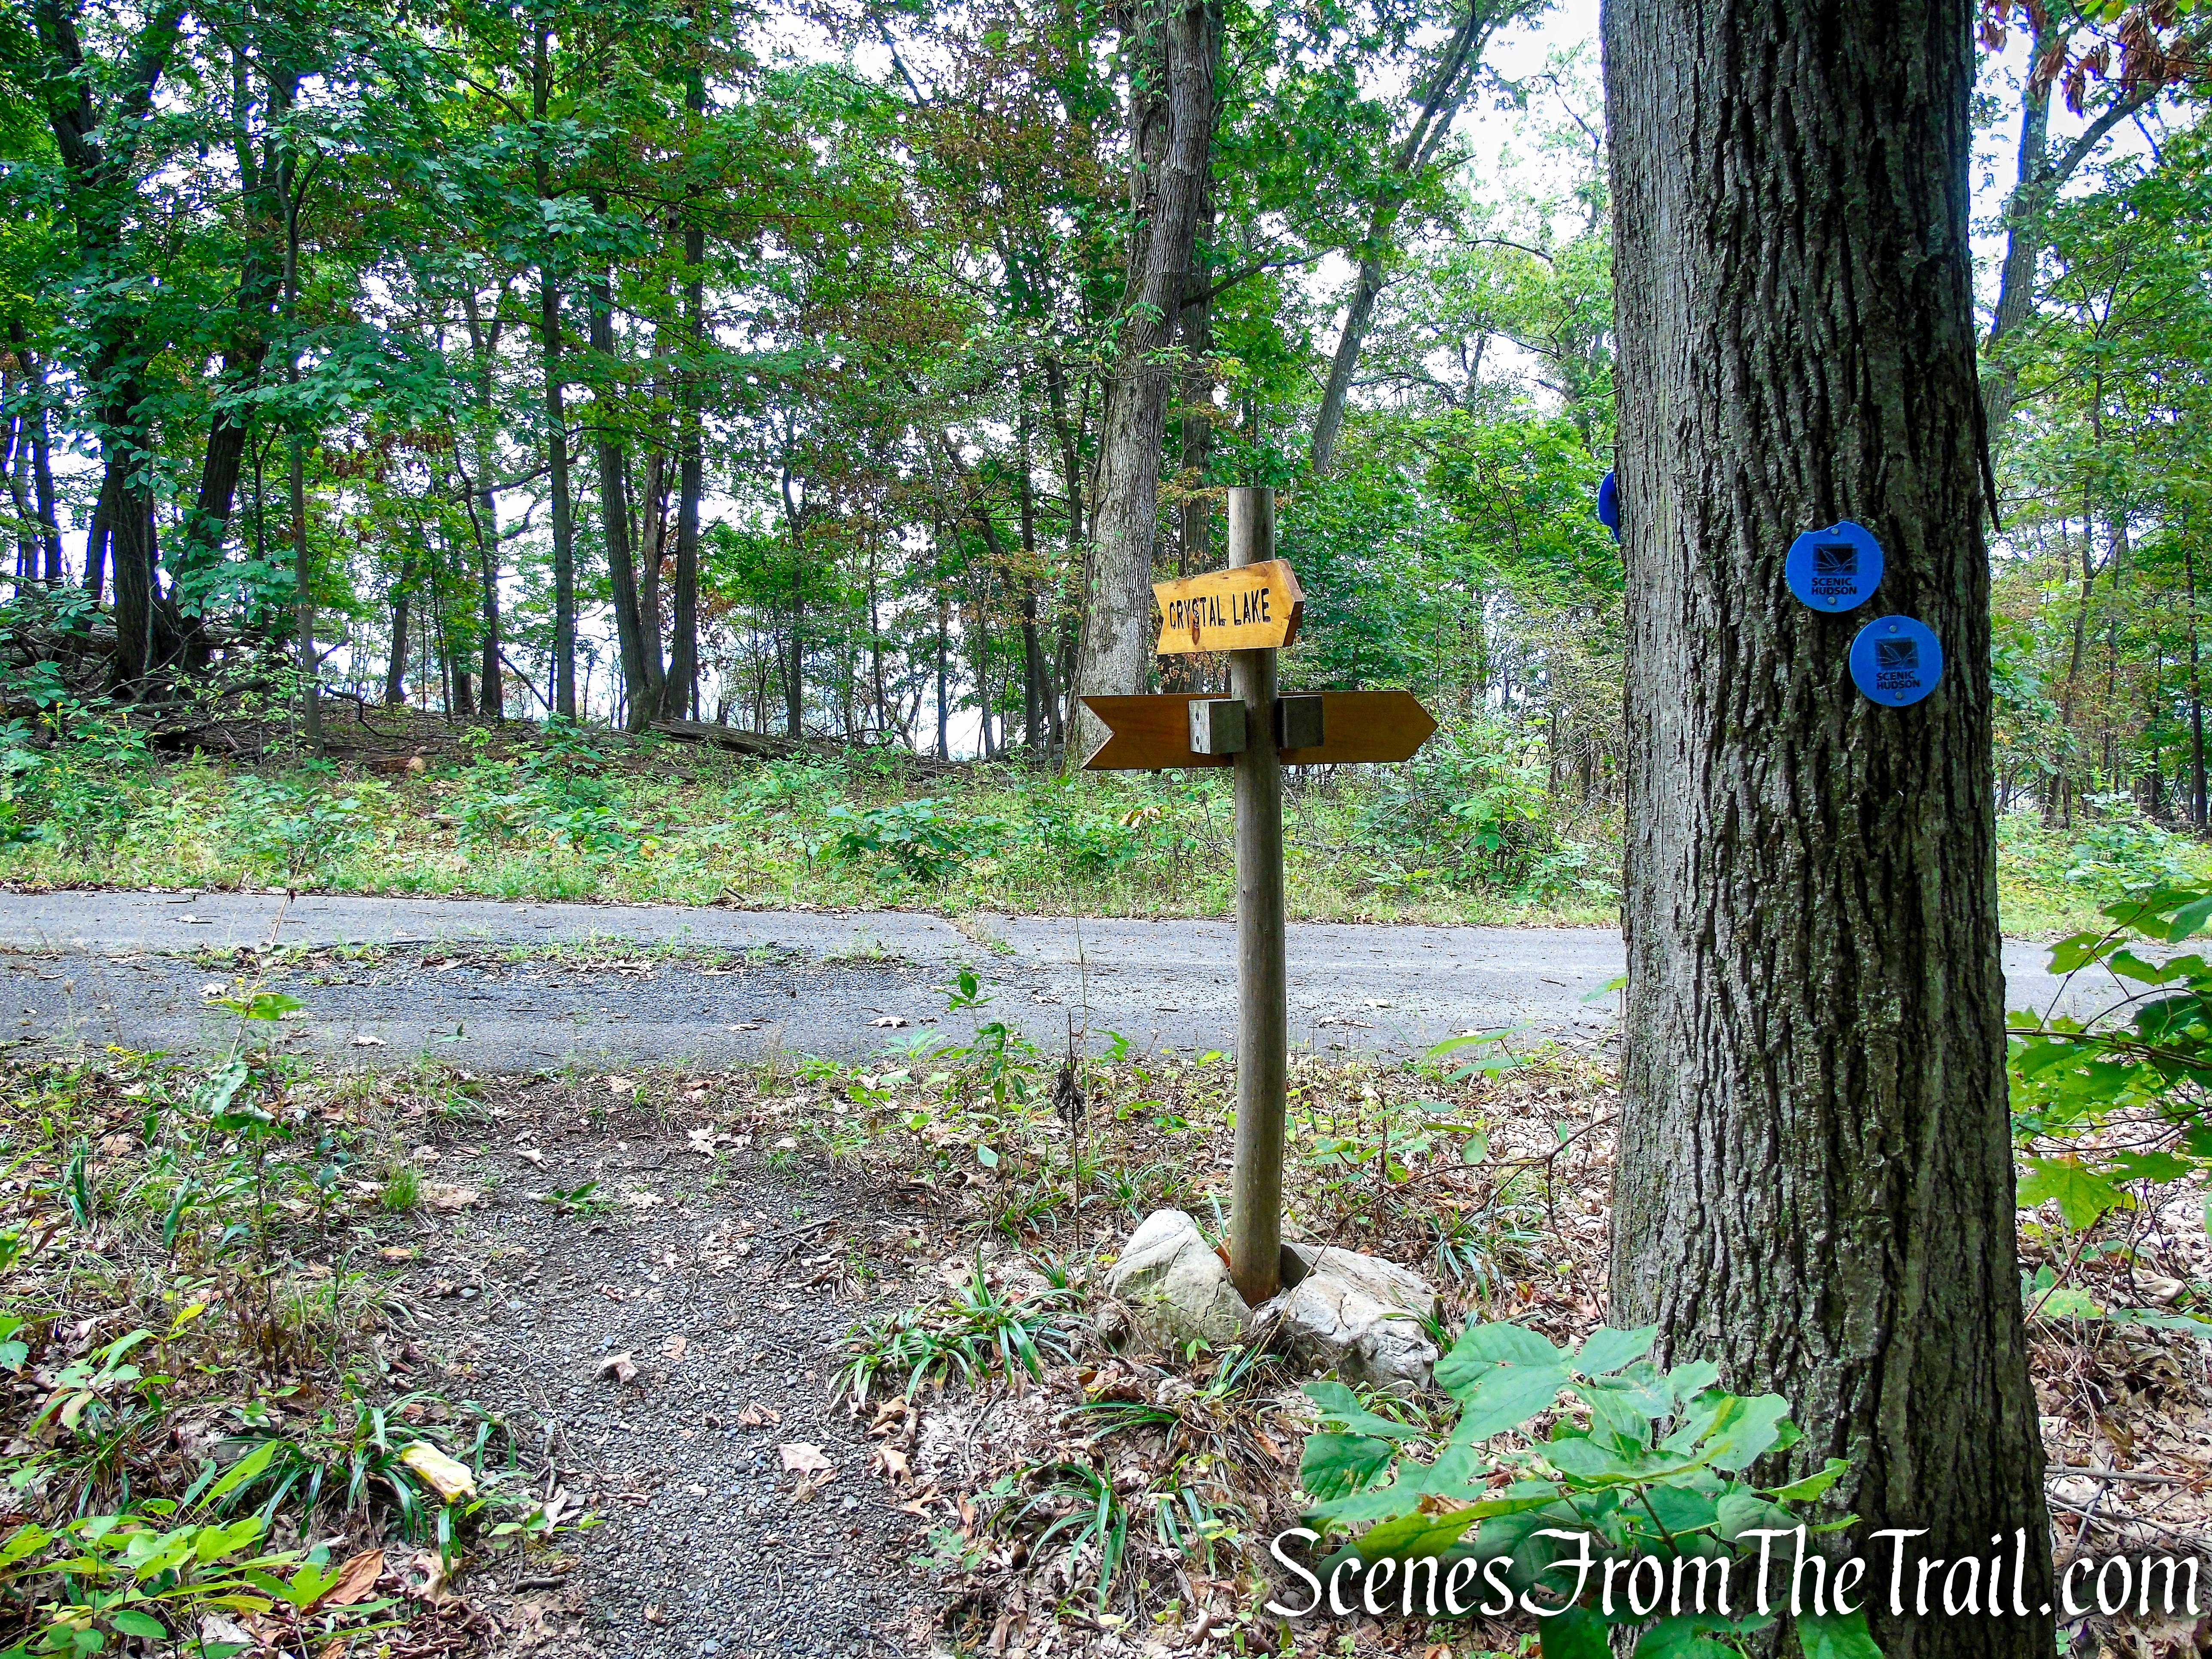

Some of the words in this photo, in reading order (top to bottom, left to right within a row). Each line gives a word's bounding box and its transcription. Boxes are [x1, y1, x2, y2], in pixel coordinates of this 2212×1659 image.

[1812, 577, 1852, 586] SCENIC
[1811, 586, 1857, 595] HUDSON
[1169, 595, 1226, 629] CRYSTAL
[1233, 588, 1271, 626] LAKE
[1876, 671, 1915, 680] SCENIC
[1876, 680, 1920, 690] HUDSON
